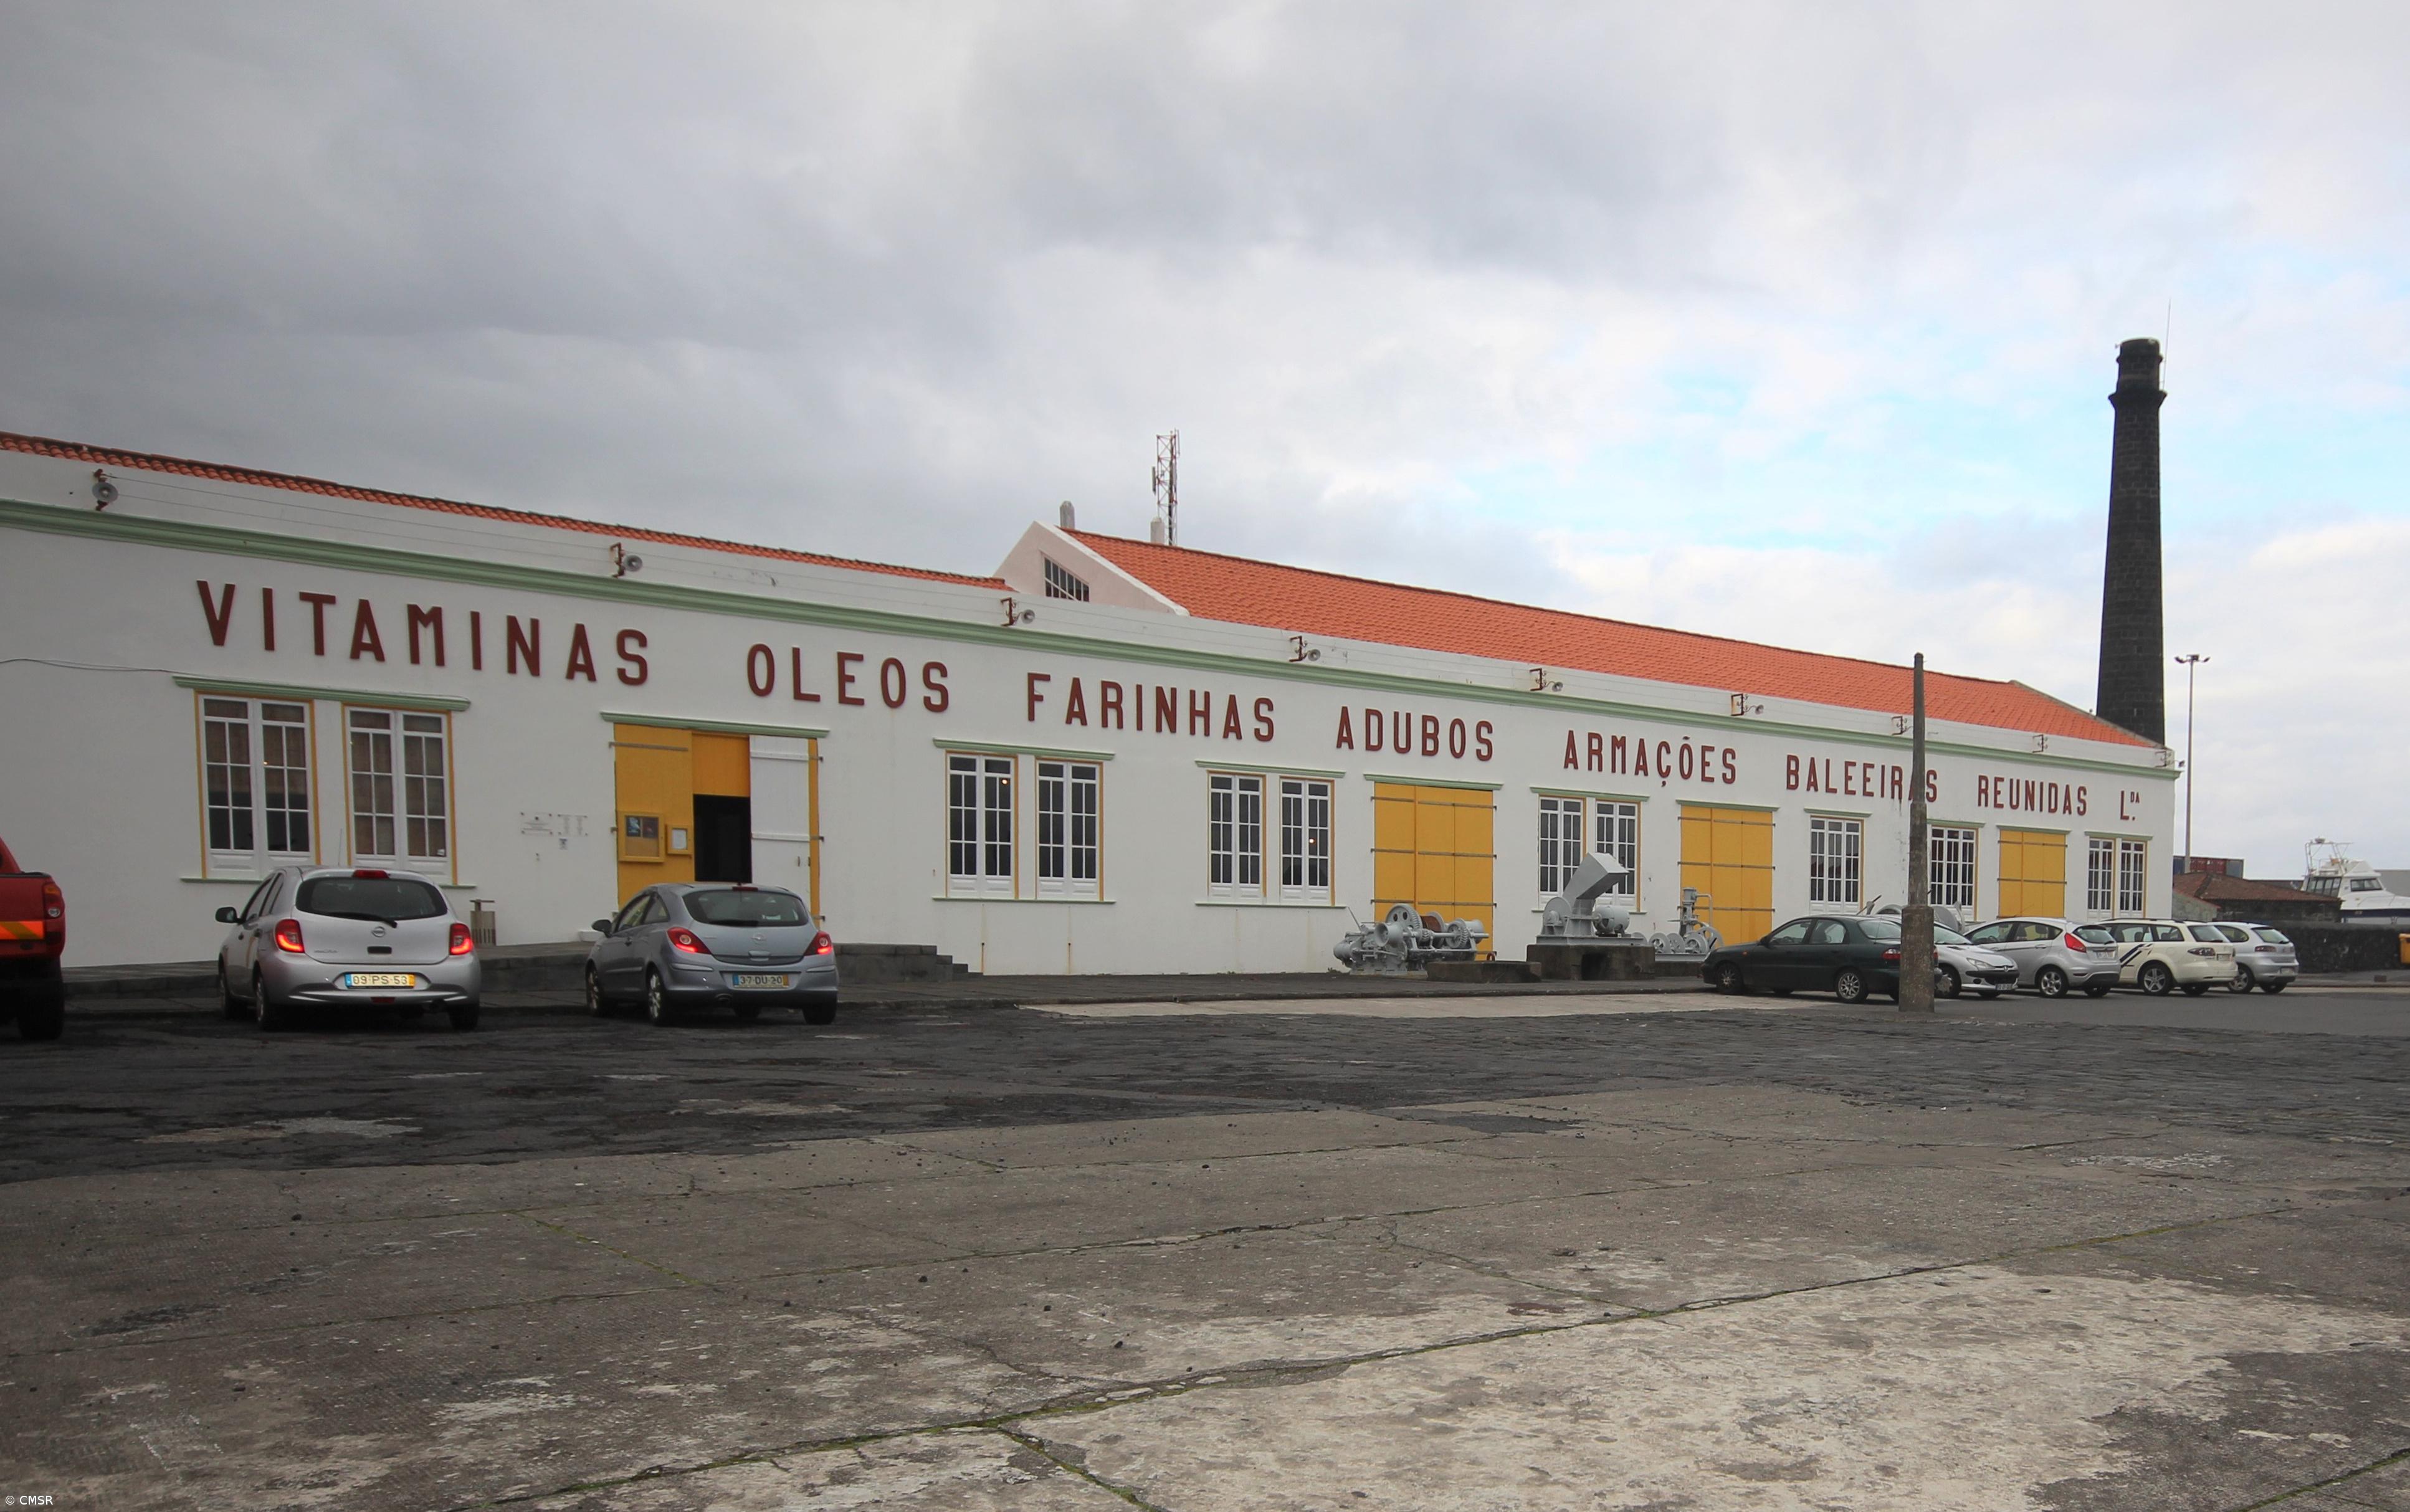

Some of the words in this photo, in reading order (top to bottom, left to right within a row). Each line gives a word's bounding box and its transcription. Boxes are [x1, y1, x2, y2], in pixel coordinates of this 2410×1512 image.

[196, 580, 648, 686] VITAMINAS
[748, 644, 949, 713] OLEOS
[1027, 673, 1274, 742] FARINHAS
[1336, 706, 1493, 761] ADUBOS
[1564, 730, 1736, 787] ARMAÇÕES
[1786, 754, 1938, 802] BALEEIRS
[1978, 775, 2087, 815] REUNIDAS
